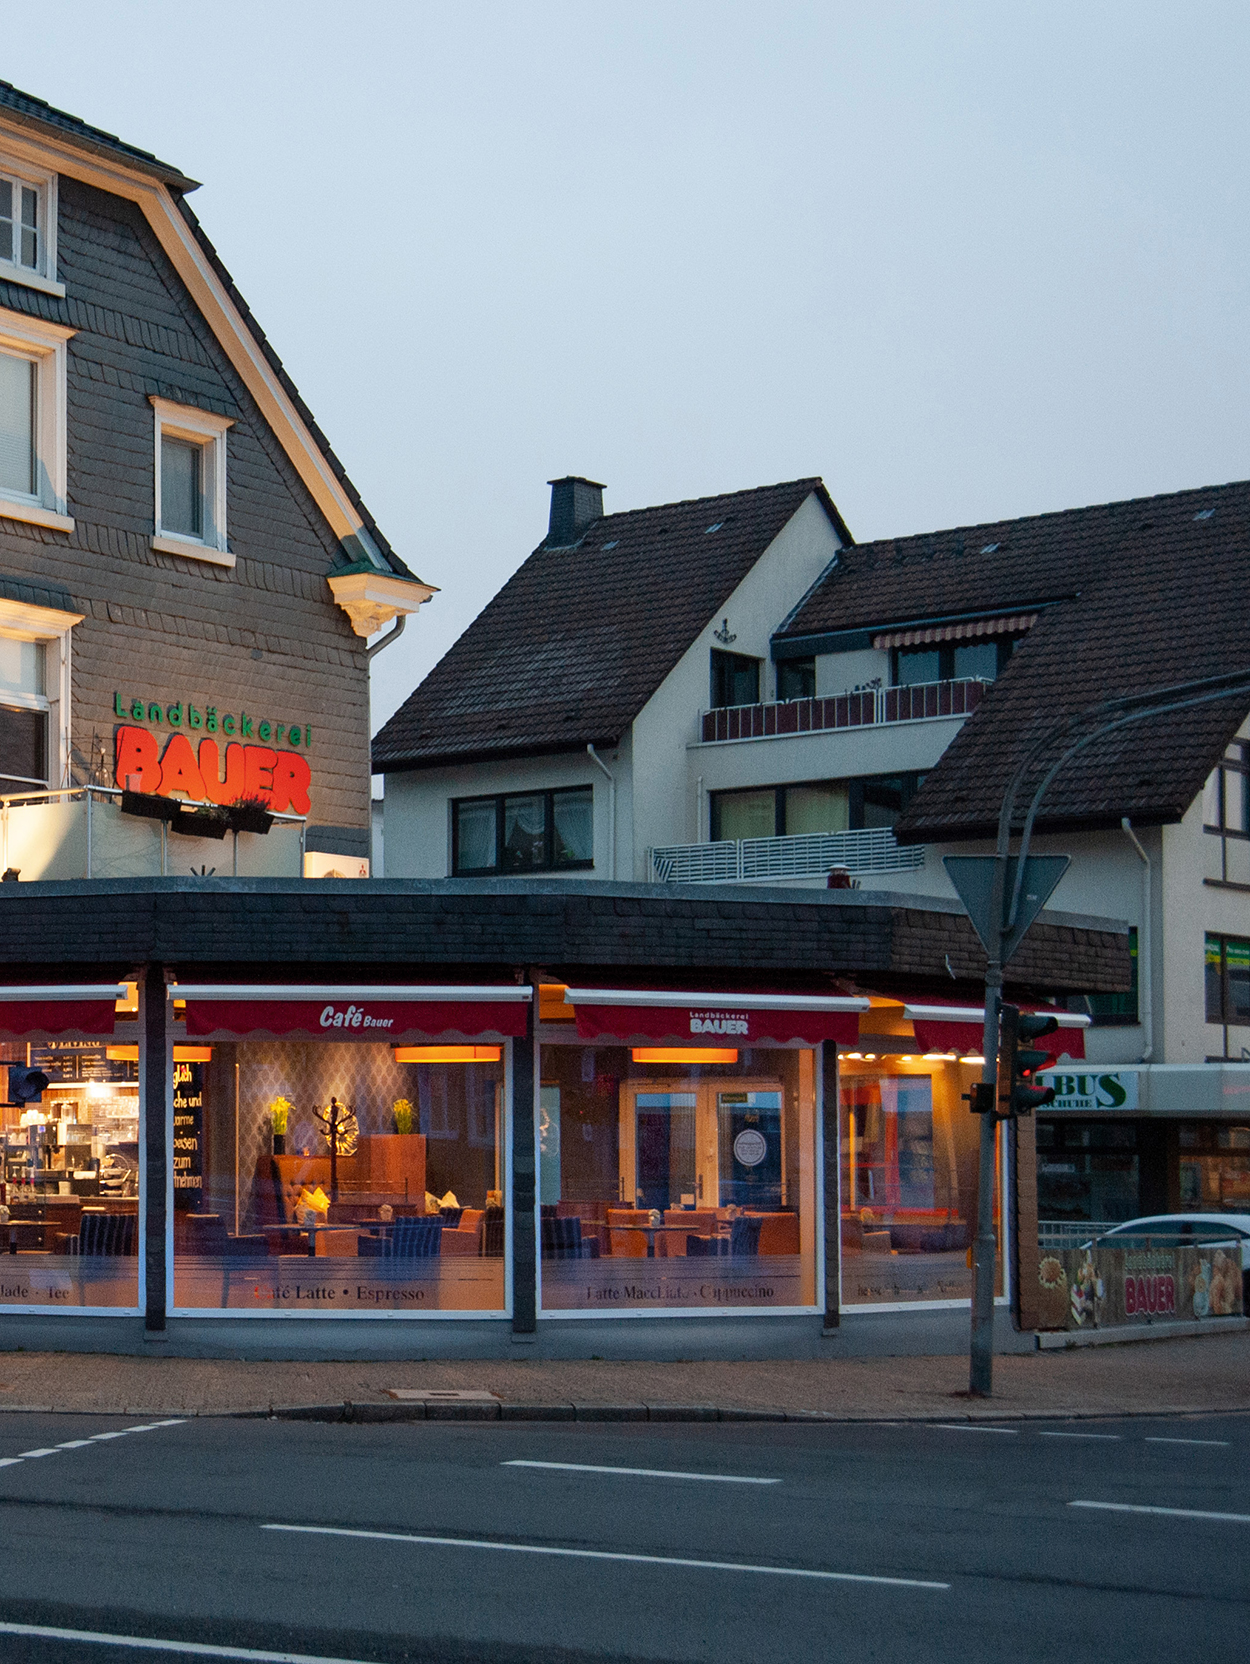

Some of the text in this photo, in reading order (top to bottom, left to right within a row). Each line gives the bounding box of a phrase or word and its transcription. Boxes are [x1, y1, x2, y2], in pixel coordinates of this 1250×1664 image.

[115, 693, 311, 748] Landbäckerei
[116, 725, 312, 815] BAUER
[319, 1005, 393, 1027] Café Bauer
[690, 1018, 748, 1035] BAUER
[188, 1091, 202, 1108] und
[173, 1156, 191, 1169] zum
[49, 1286, 69, 1299] Tee
[296, 1285, 336, 1300] Latte
[357, 1285, 425, 1303] Espresso
[1124, 1273, 1176, 1316] BAUER
